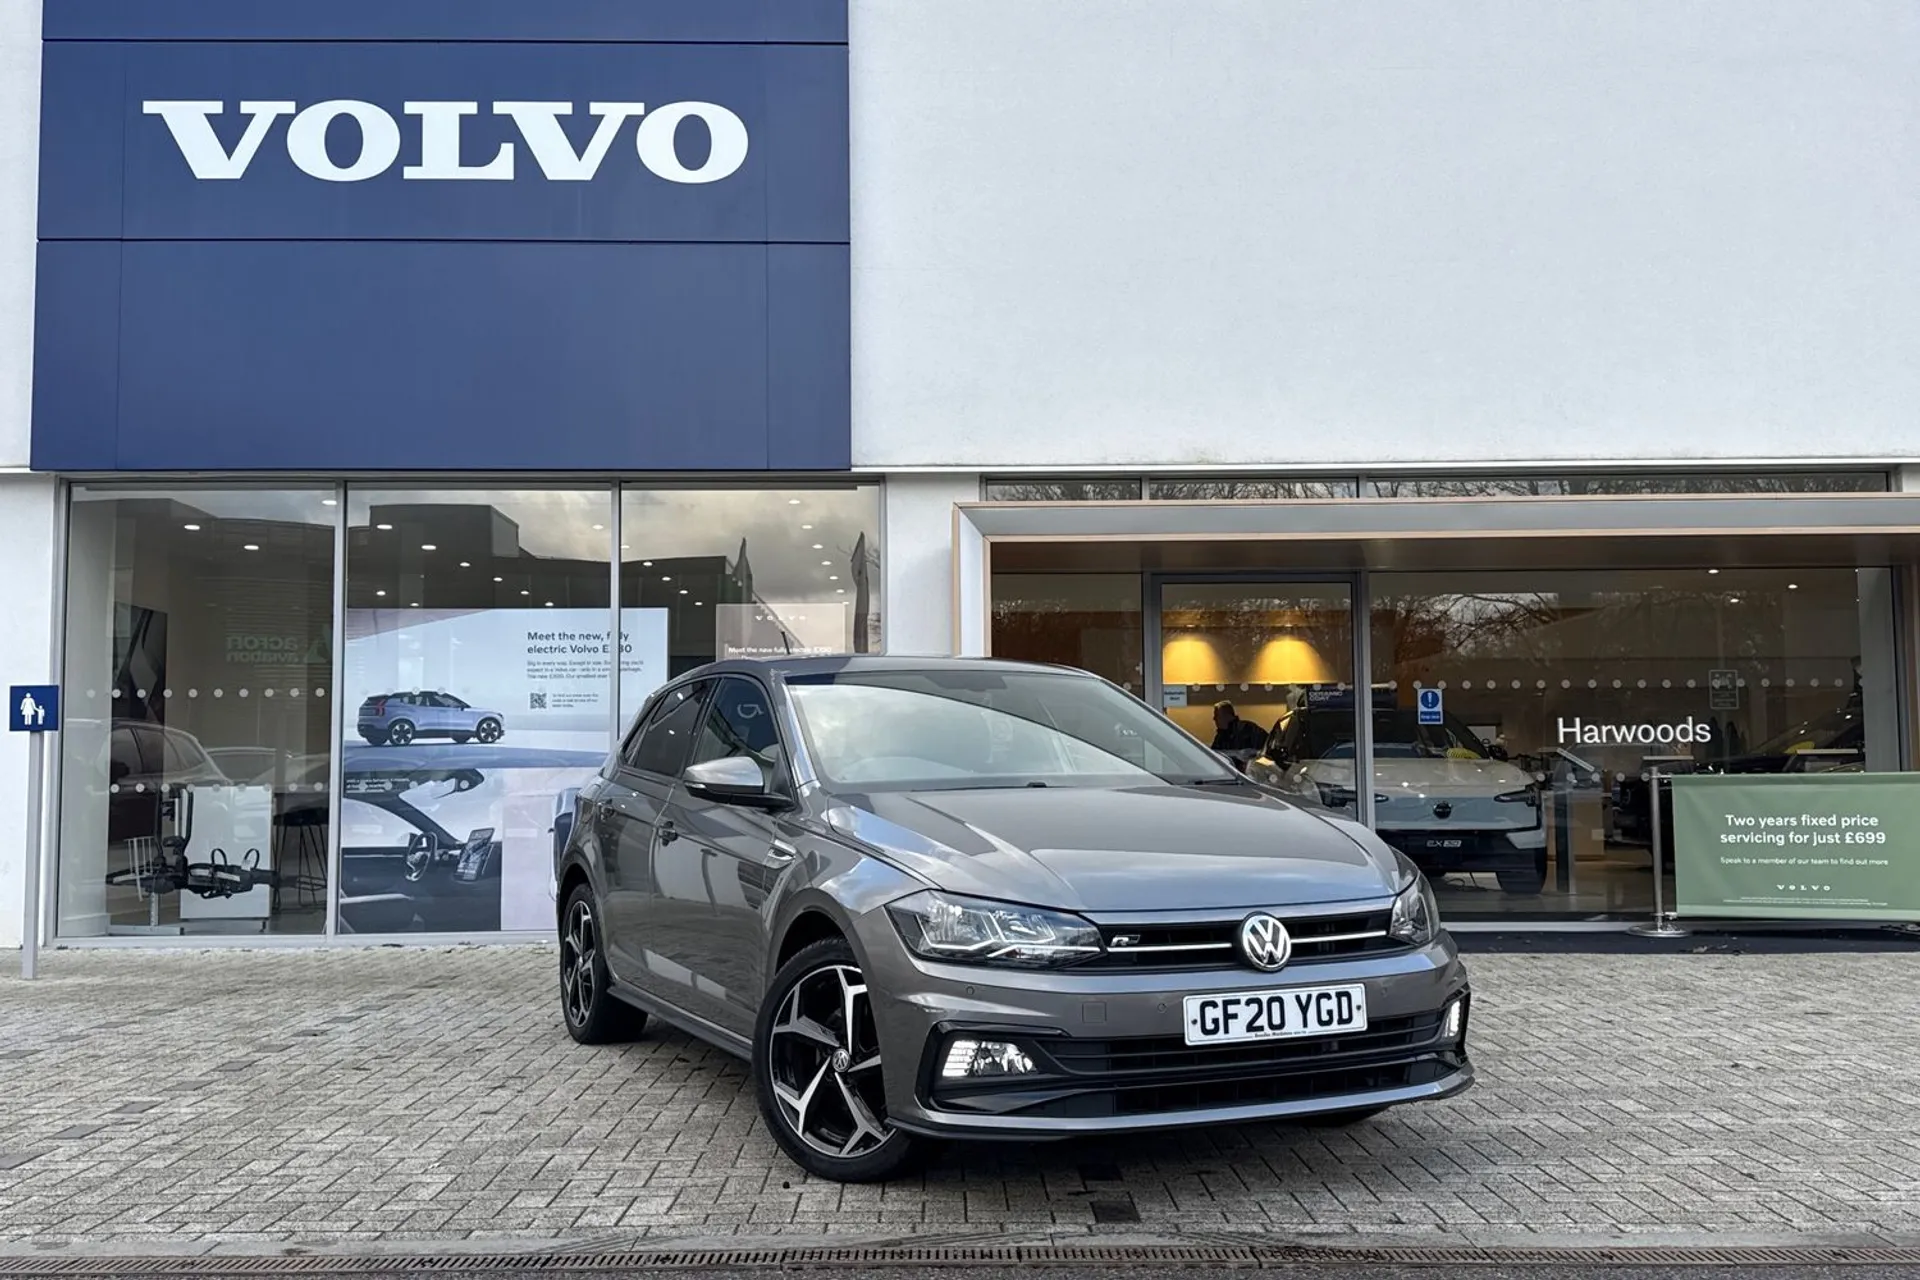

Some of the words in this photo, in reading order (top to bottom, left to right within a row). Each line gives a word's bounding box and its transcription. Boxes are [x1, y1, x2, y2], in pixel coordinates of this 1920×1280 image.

[143, 99, 749, 184] VOLVO
[527, 631, 555, 641] Meet
[558, 631, 576, 641] the
[578, 632, 604, 642] new,
[527, 644, 567, 653] electric
[569, 644, 599, 653] Volvo
[602, 644, 632, 653] E30
[1556, 716, 1712, 744] Harwoods
[1725, 814, 1755, 827] Two
[1759, 816, 1797, 829] years
[1800, 814, 1837, 827] fixed
[1841, 814, 1879, 829] price
[1720, 831, 1785, 846] servicing
[1788, 831, 1809, 844] for
[1812, 832, 1841, 846] just
[1845, 831, 1887, 845] £699
[1720, 857, 1741, 865] Speak
[1758, 857, 1786, 865] member
[1839, 857, 1854, 866] find
[1856, 858, 1868, 866] out
[1199, 996, 1286, 1036] GF20
[1295, 990, 1353, 1029] YGD
